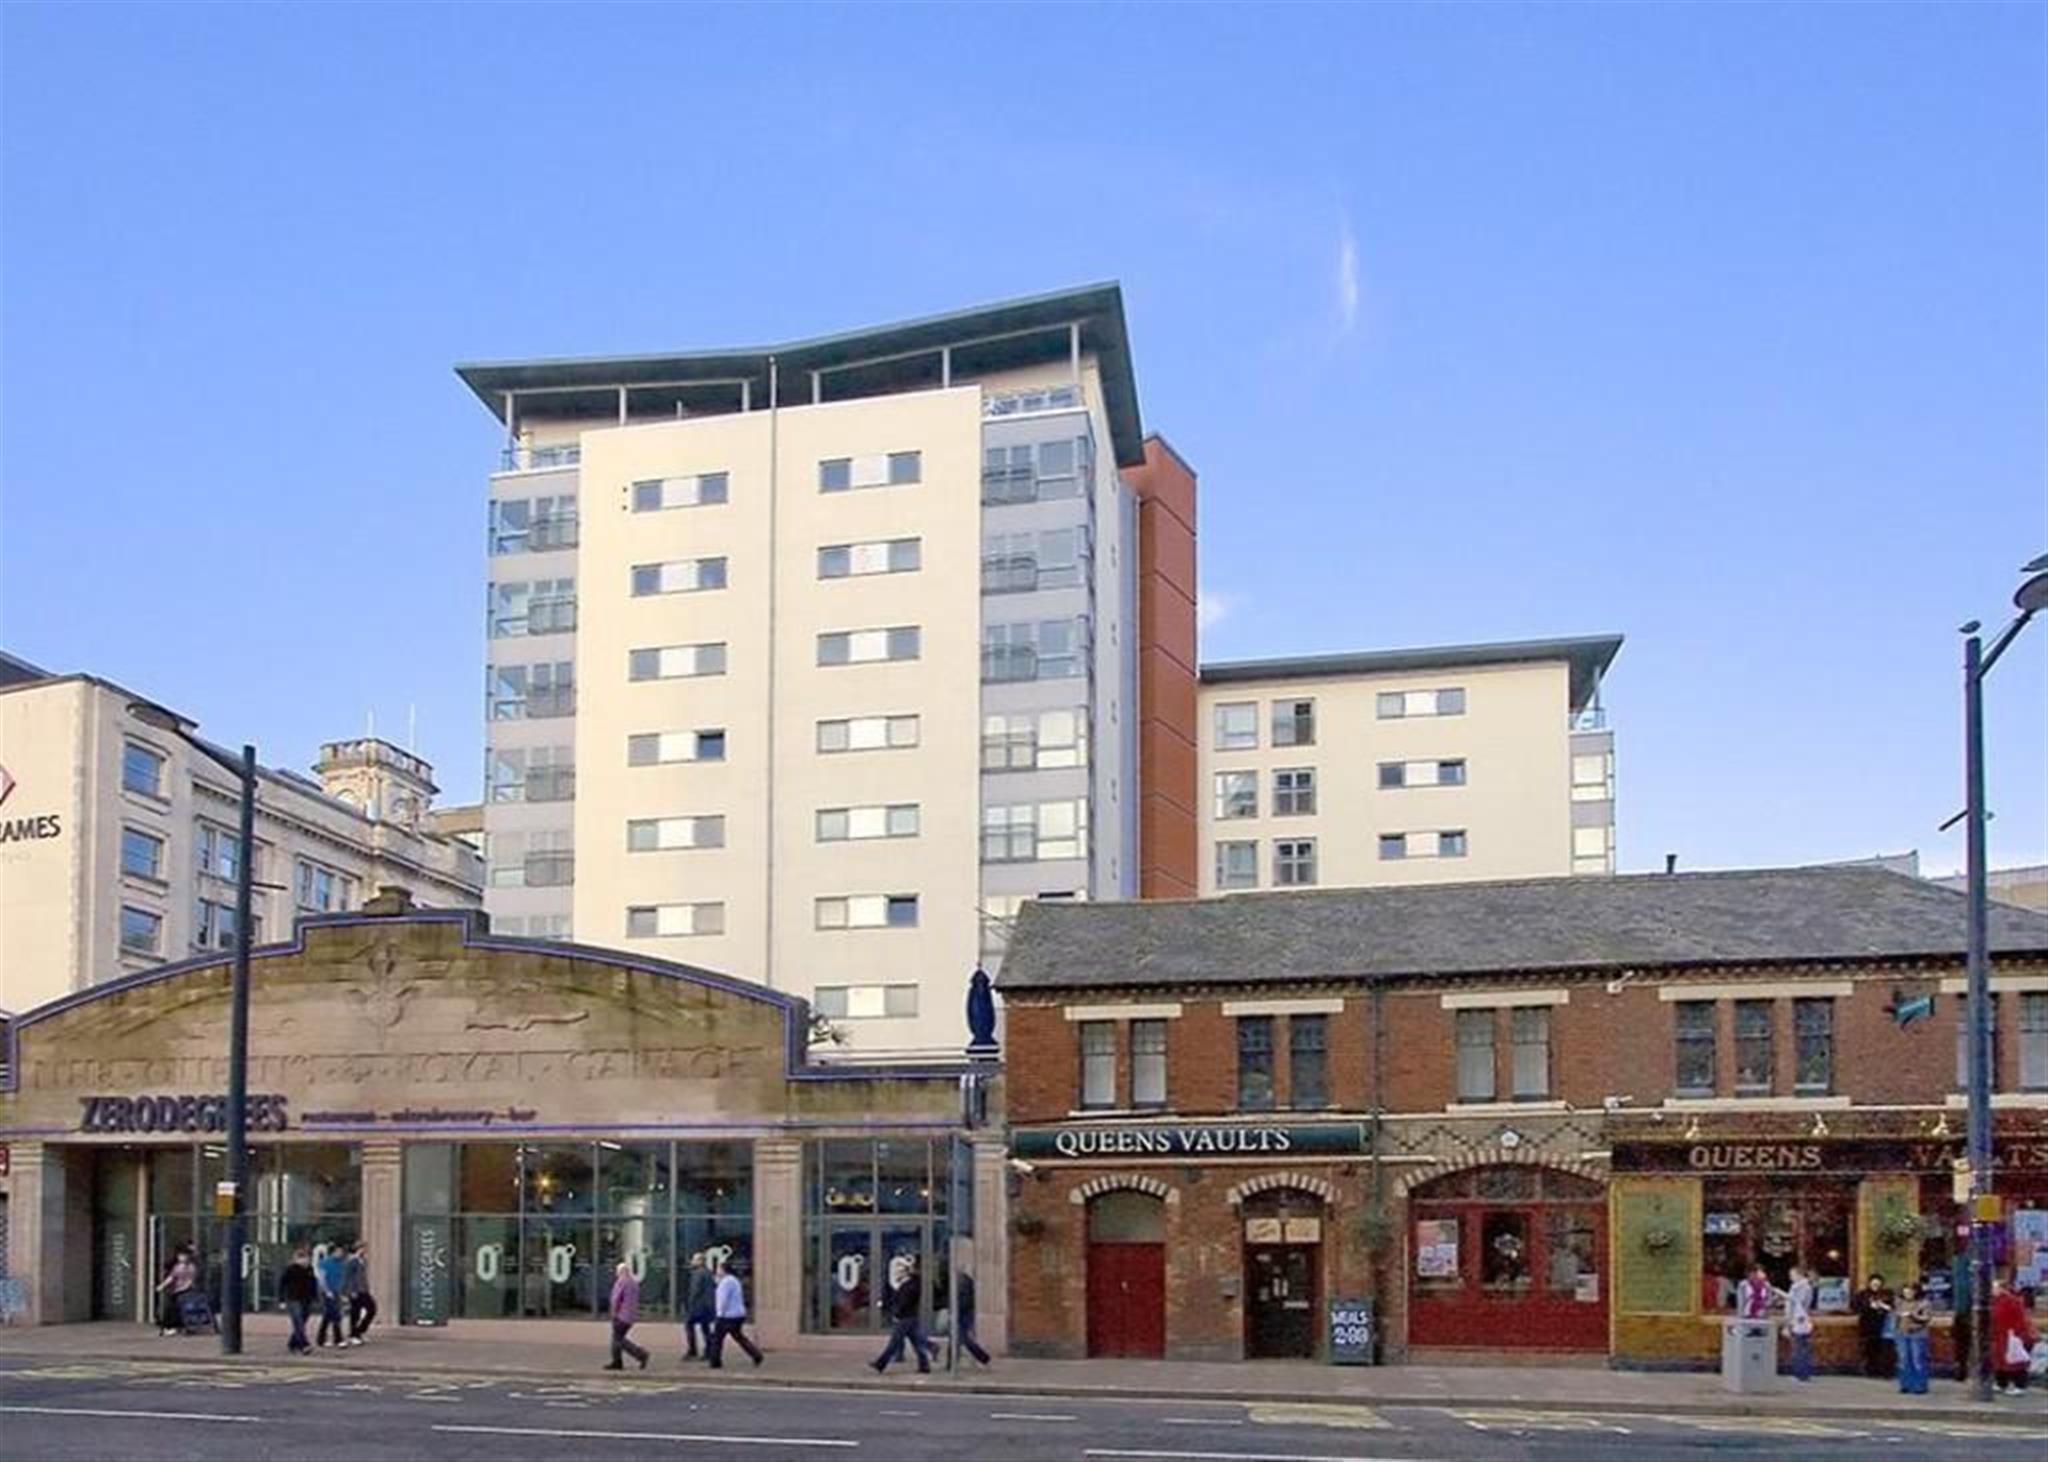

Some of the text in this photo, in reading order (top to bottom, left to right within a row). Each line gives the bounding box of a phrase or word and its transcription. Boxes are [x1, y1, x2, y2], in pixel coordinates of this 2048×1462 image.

[0, 814, 61, 843] AMES
[1056, 1128, 1290, 1156] QUEENS VAULTS
[1689, 1144, 2048, 1168] QUEENS VATS
